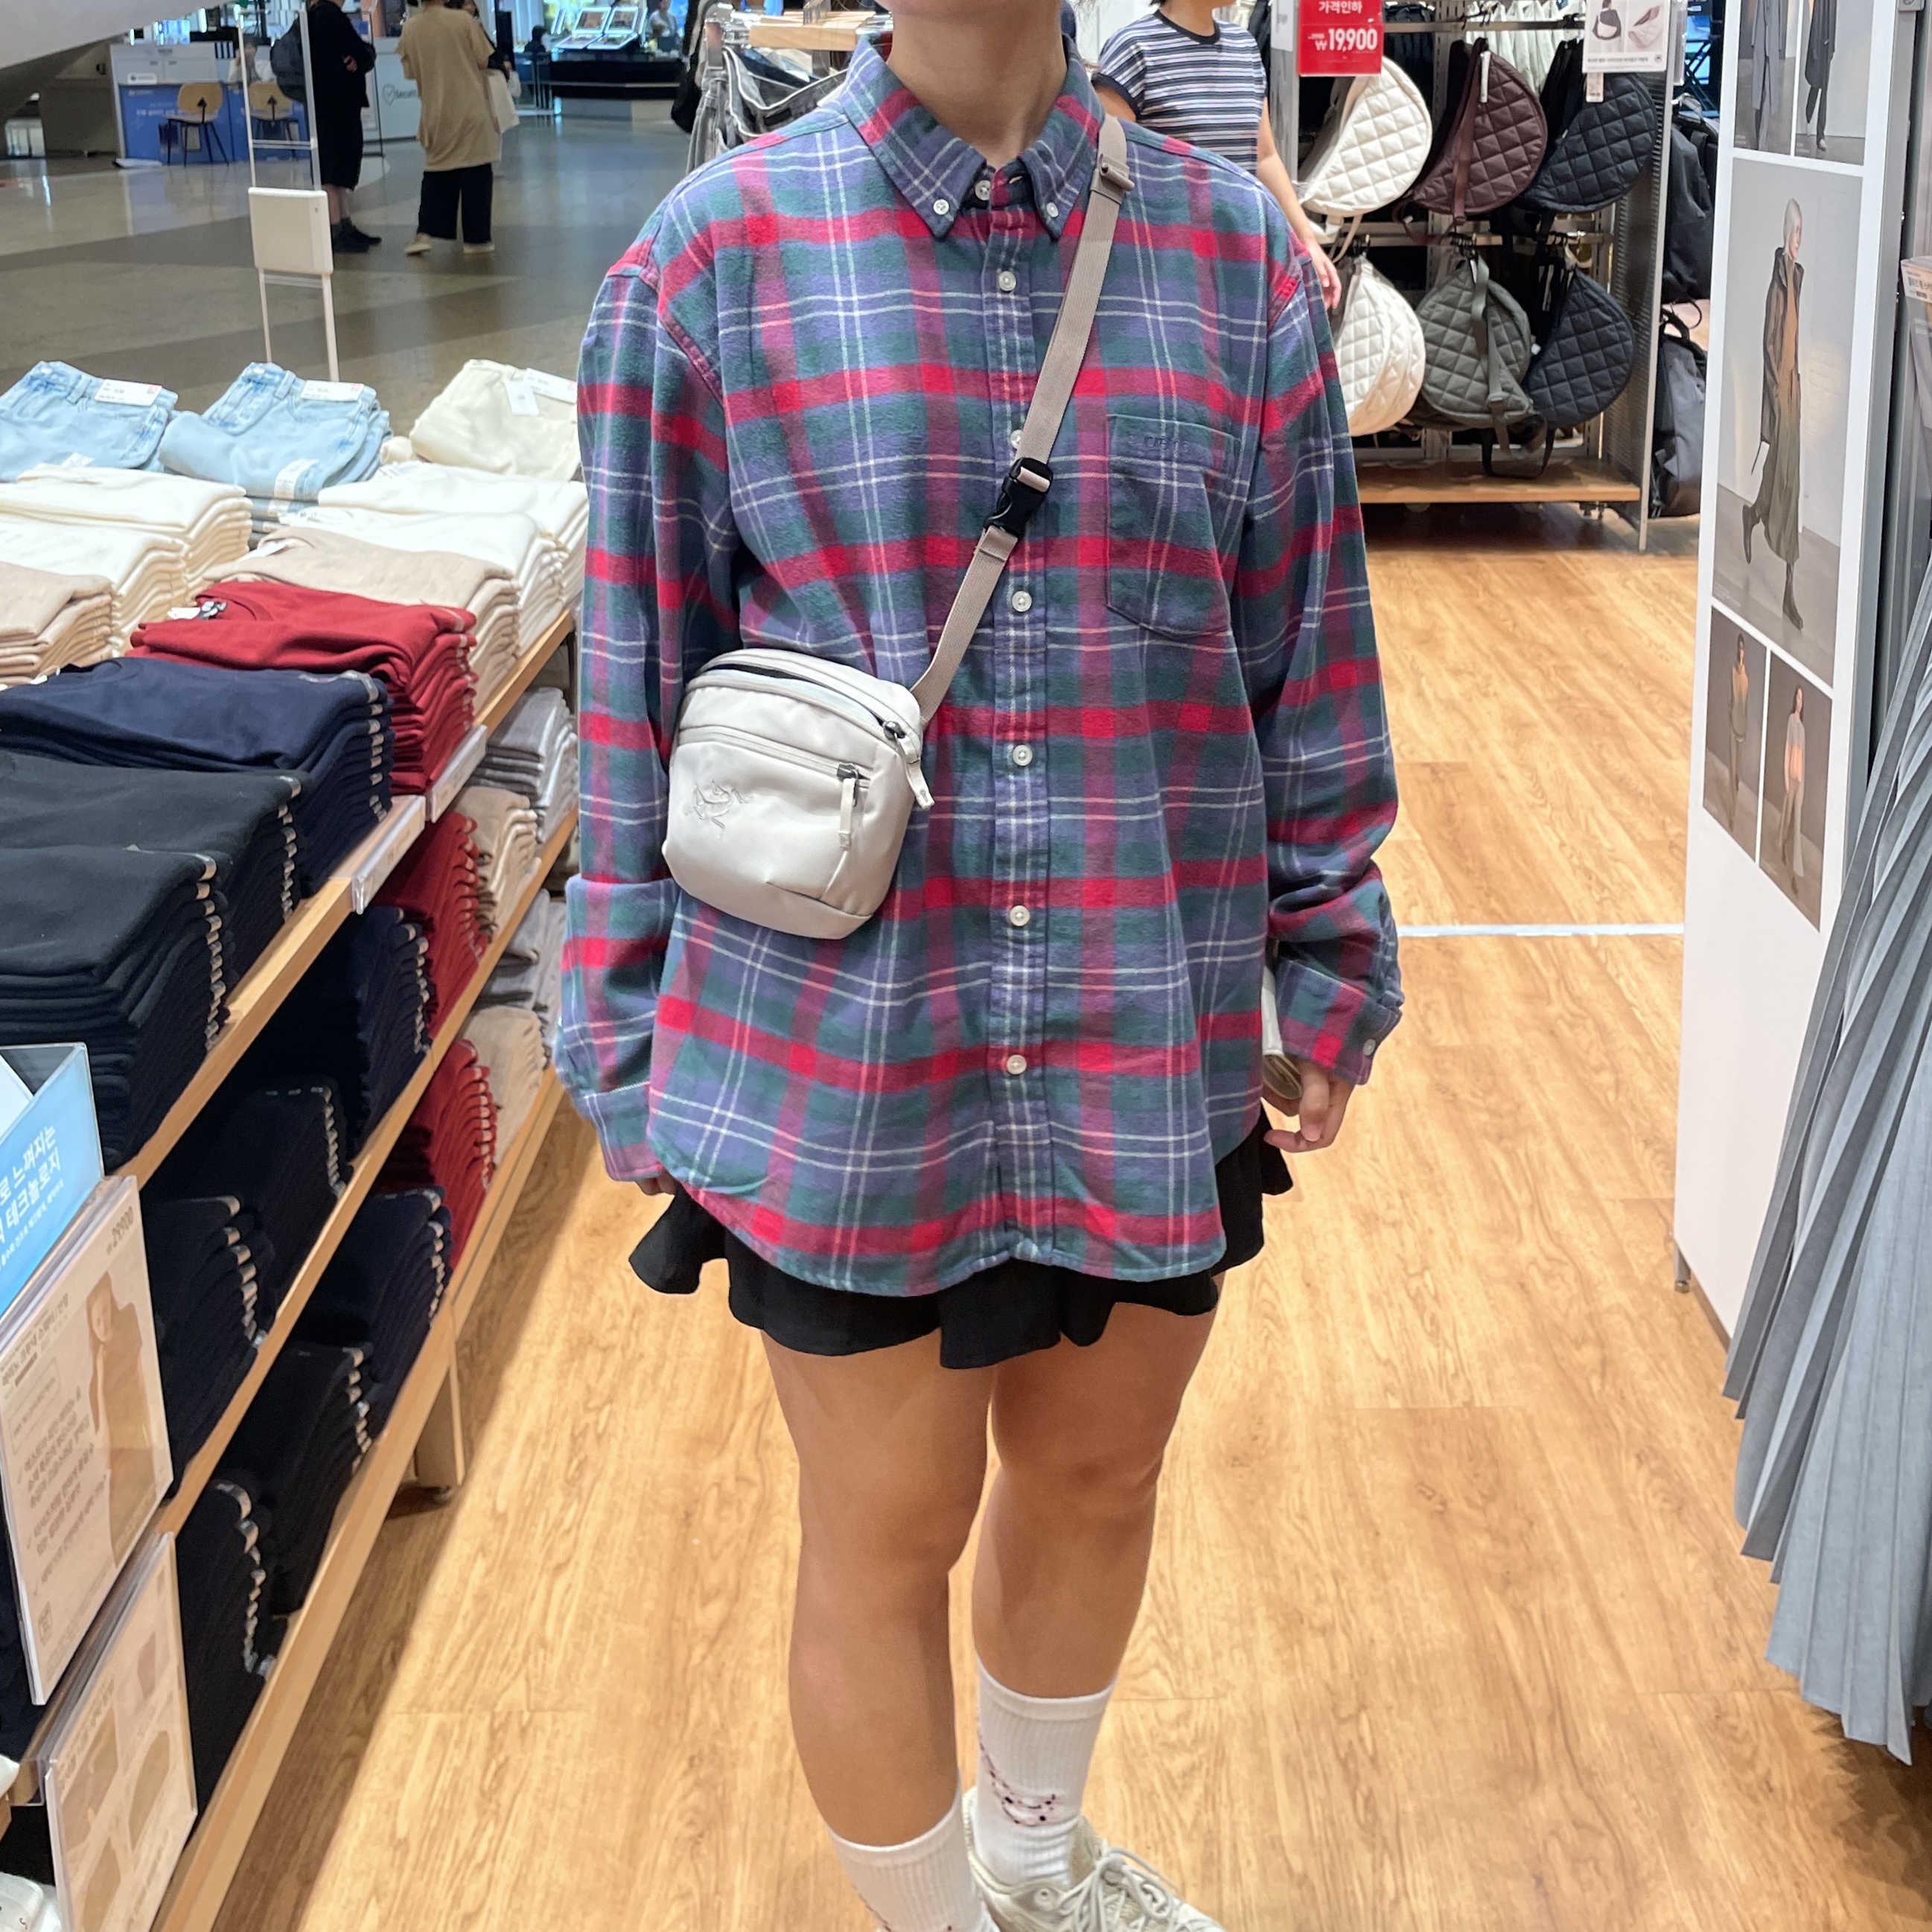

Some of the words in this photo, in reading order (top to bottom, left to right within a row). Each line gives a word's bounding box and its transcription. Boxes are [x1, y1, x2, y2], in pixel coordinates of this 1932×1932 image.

[1319, 0, 1362, 14] 가격인하
[5, 1146, 61, 1229] 테크놀로지
[12, 1125, 56, 1190] 느껴지는
